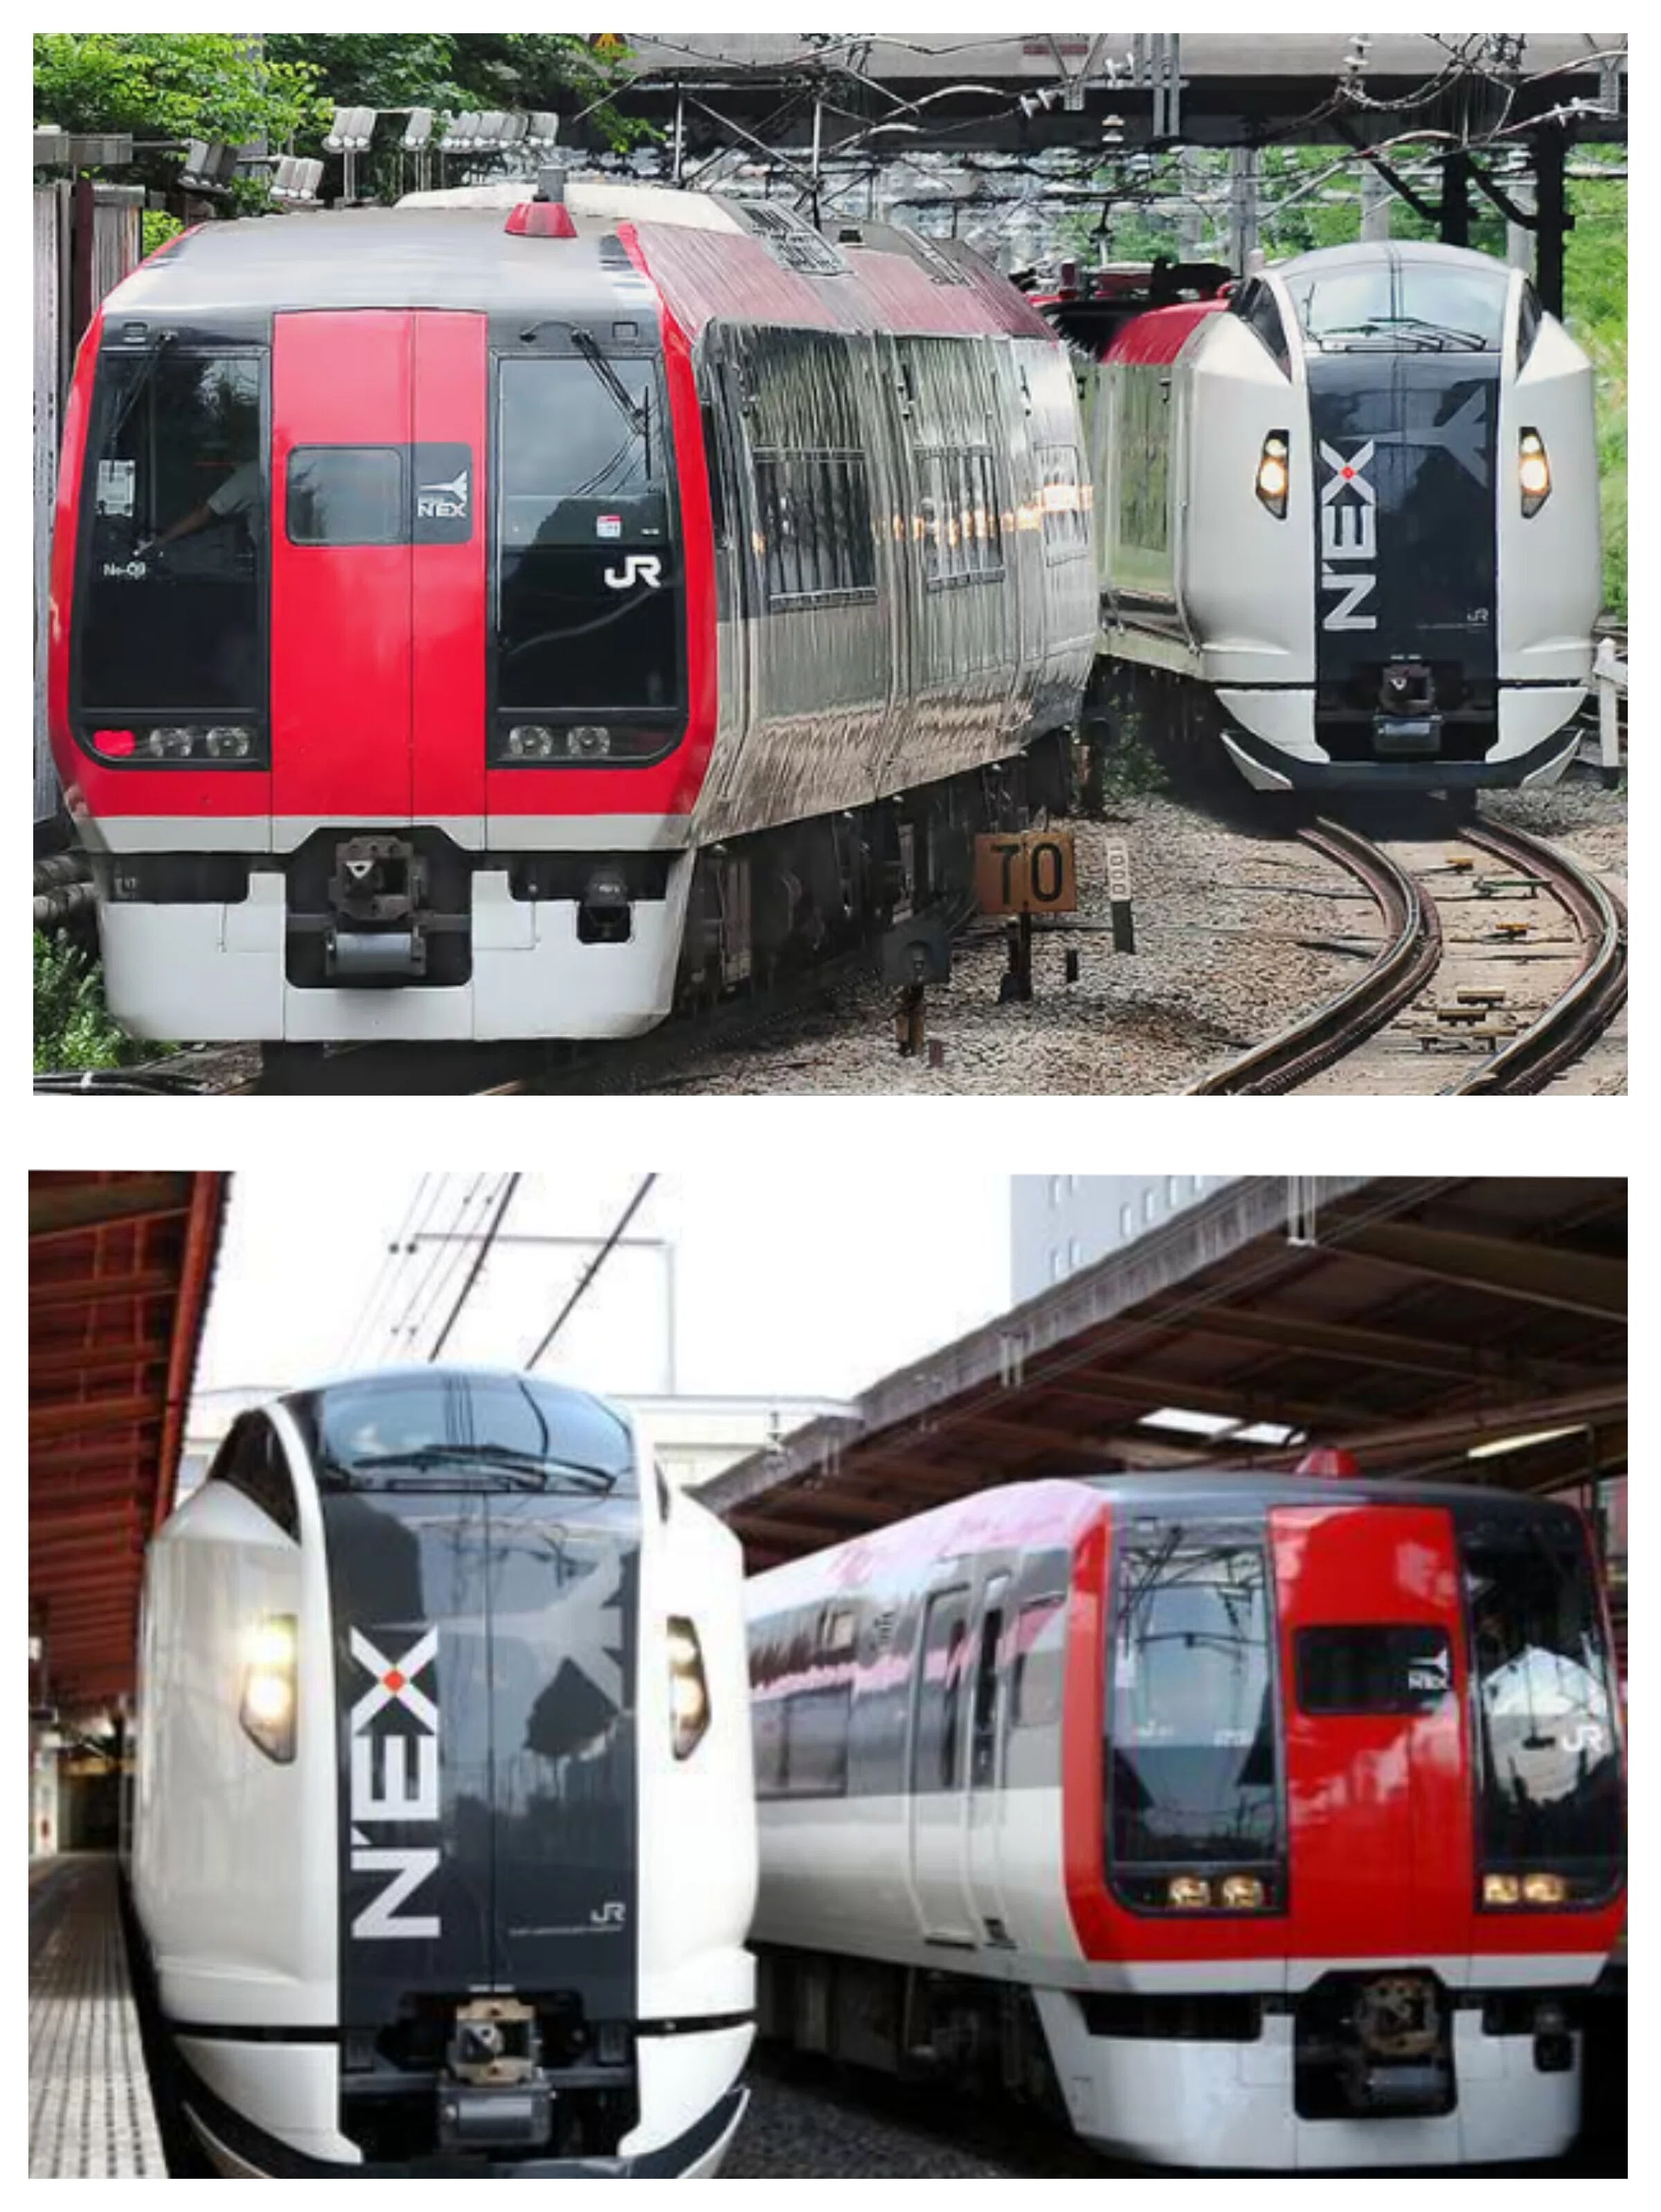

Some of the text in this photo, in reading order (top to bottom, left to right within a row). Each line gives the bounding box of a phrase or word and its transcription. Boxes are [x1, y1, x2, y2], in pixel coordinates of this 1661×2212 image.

[604, 555, 661, 588] JR
[1467, 607, 1489, 622] JR
[1561, 1725, 1601, 1752] JR
[590, 1901, 626, 1923] JR
